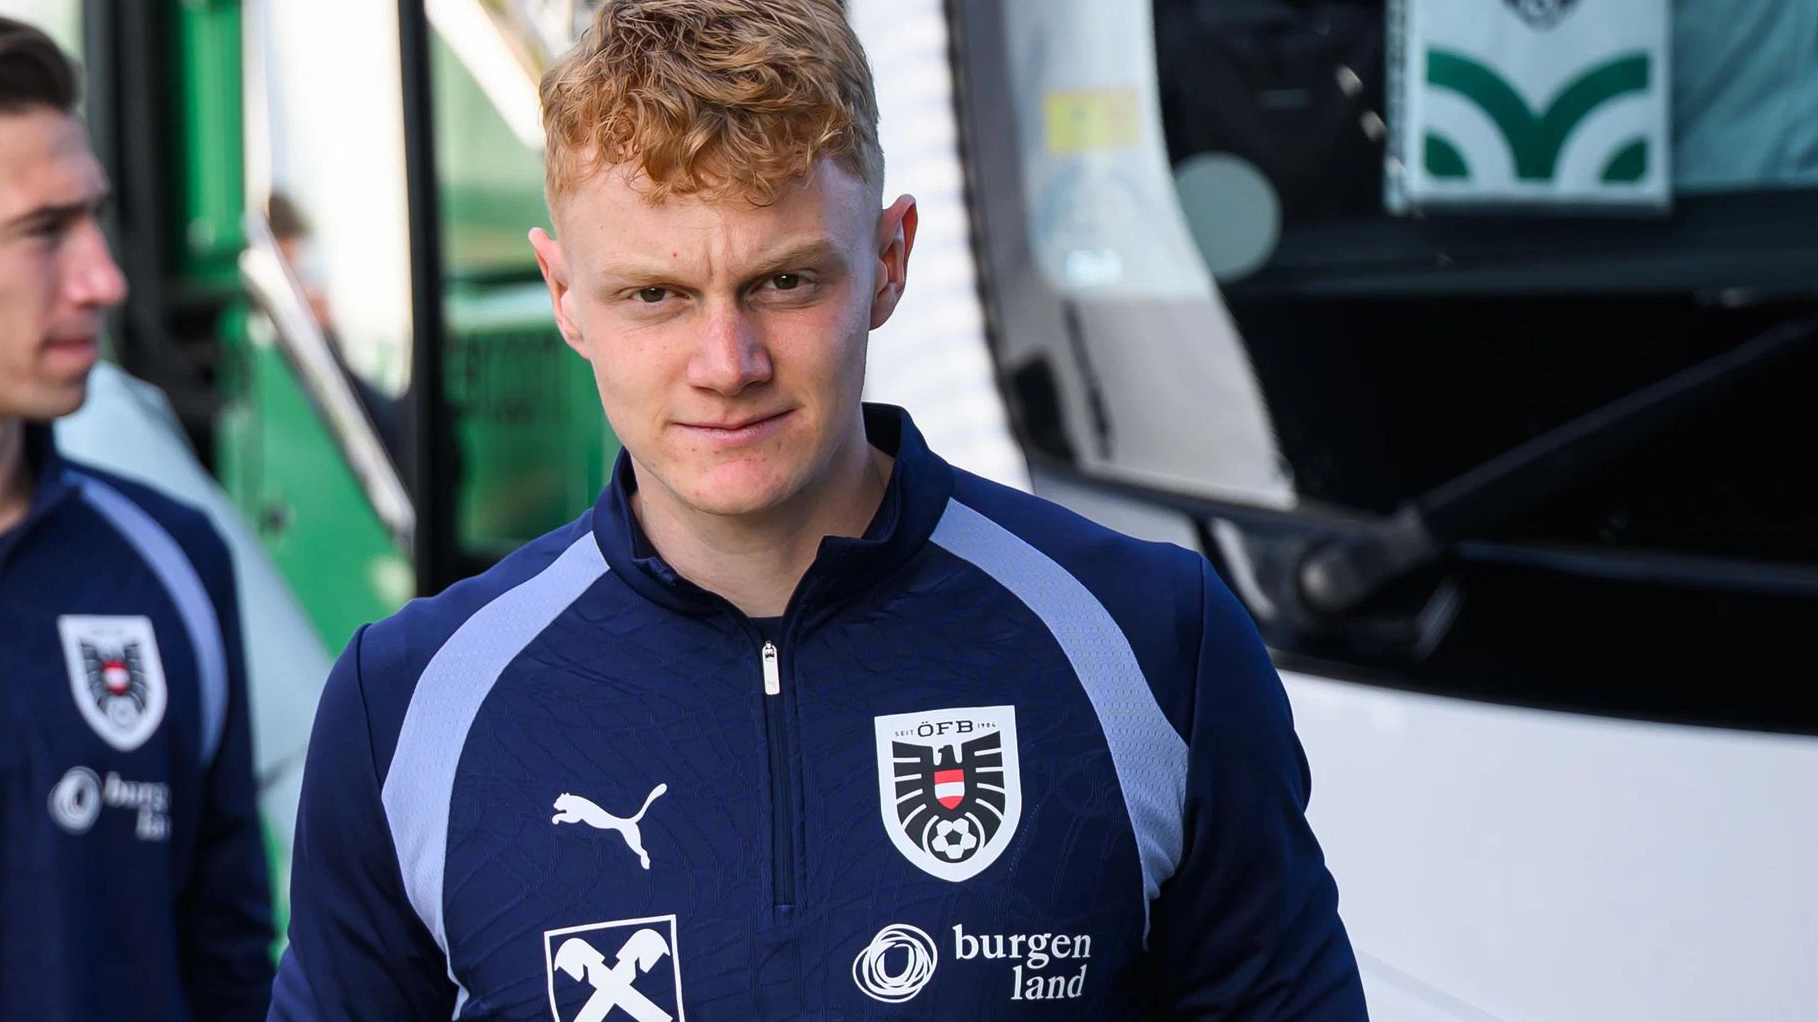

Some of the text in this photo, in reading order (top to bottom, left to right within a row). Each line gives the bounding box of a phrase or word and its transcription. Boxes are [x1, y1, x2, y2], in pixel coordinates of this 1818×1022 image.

[917, 720, 974, 737] ÖFB
[952, 923, 1091, 969] burgen
[1010, 964, 1087, 1000] land
